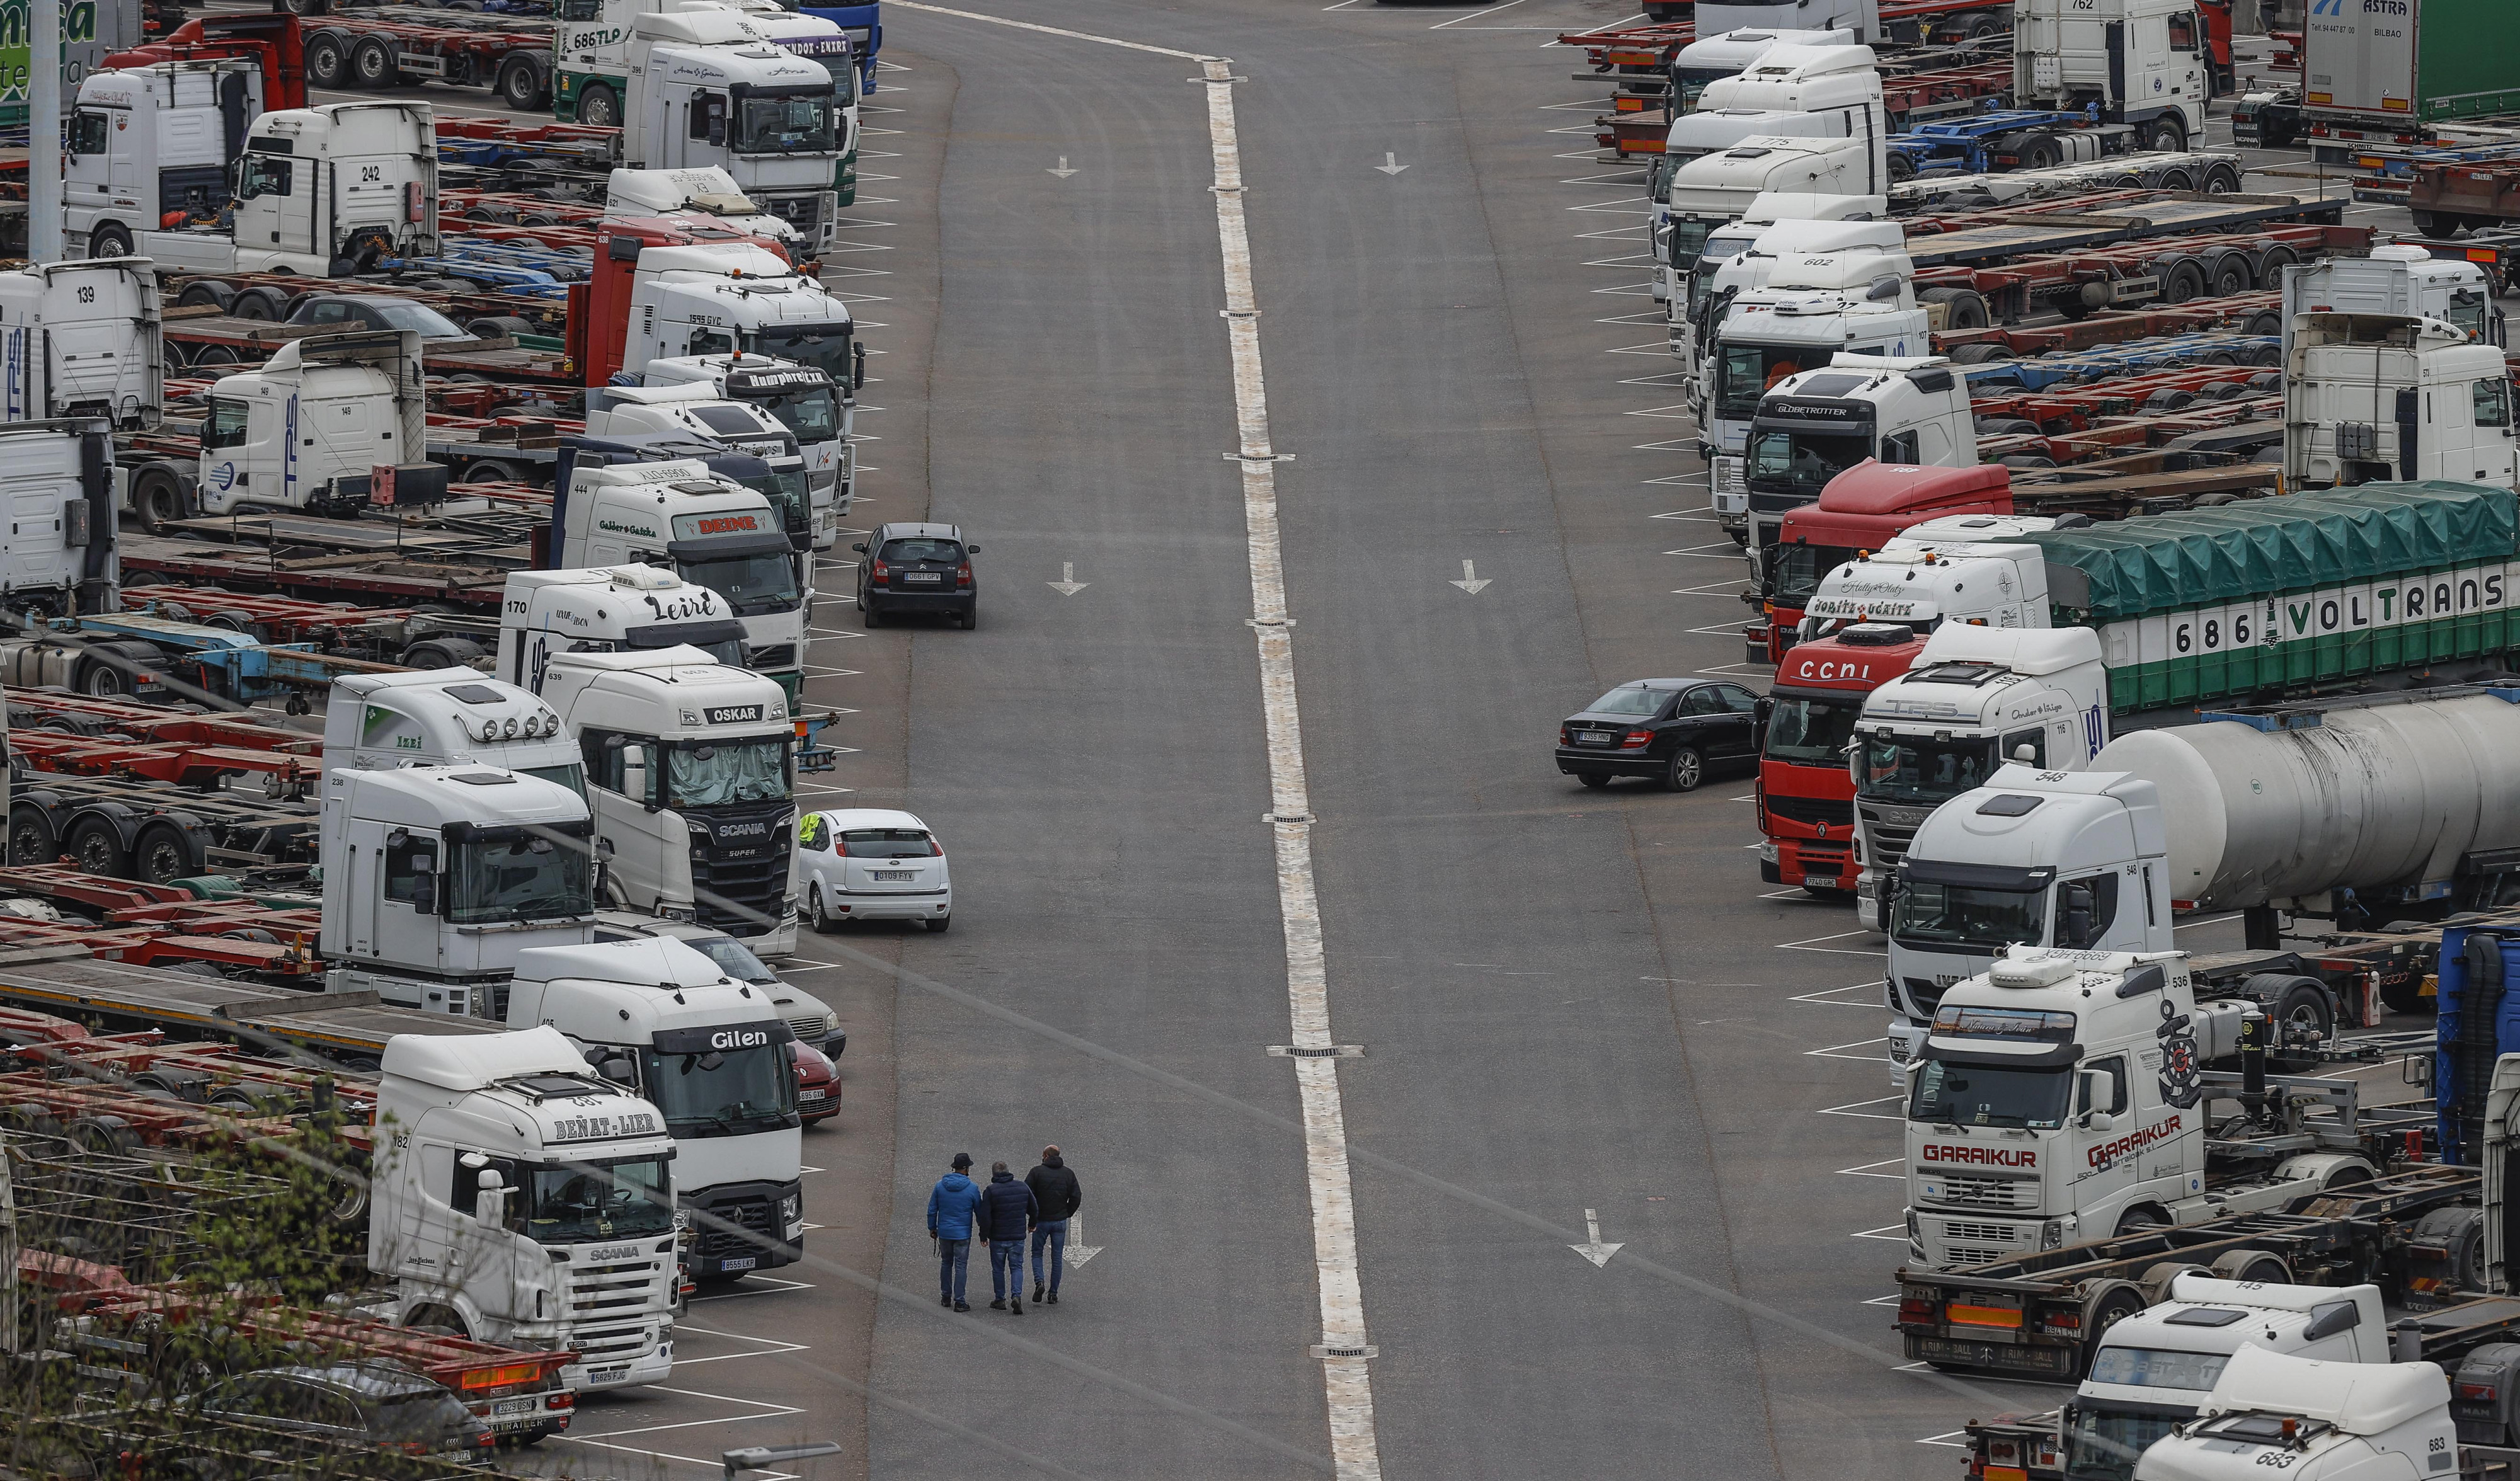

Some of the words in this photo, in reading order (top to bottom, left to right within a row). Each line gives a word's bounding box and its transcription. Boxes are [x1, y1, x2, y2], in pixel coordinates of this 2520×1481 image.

[2072, 0, 2093, 9] 762
[2363, 0, 2407, 16] ASTRA
[575, 32, 595, 50] 686
[597, 28, 621, 45] TLP
[2374, 28, 2402, 38] BILBAO
[632, 66, 642, 74] 396
[1870, 93, 1880, 101] 744
[362, 166, 381, 181] 242
[609, 198, 618, 207] 621
[598, 236, 609, 244] 638
[77, 285, 95, 304] 139
[689, 314, 706, 323] 1595
[707, 315, 722, 326] GYC
[1918, 330, 1927, 340] 107
[8, 327, 22, 424] TPS
[260, 386, 269, 396] 149
[341, 406, 352, 416] 149
[1777, 405, 1847, 416] GLOBETROTTER
[285, 393, 297, 498] TPS
[575, 484, 588, 495] 444
[698, 515, 757, 534] DEINE
[1841, 580, 1874, 597] Holly
[508, 600, 527, 614] 170
[2288, 574, 2502, 635] VOLTRANS
[556, 609, 572, 620] UXUE
[2176, 614, 2250, 653] 686
[548, 673, 562, 681] 639
[1886, 699, 1958, 716] TPS
[713, 707, 757, 722] OSKAR
[2057, 723, 2066, 735] 116
[1583, 732, 1597, 740] 9355
[1598, 733, 1609, 741] HNG
[332, 778, 344, 787] 238
[2035, 772, 2068, 782] 548
[719, 823, 766, 838] SCANIA
[899, 872, 912, 880] FYV
[2126, 864, 2137, 876] 548
[1823, 878, 1836, 886] GRC
[2172, 975, 2187, 988] 536
[711, 1030, 767, 1049] Gilen
[813, 1089, 825, 1099] GXM
[2087, 1114, 2181, 1169] GARAIKUR
[1923, 1144, 2036, 1168] GARAIKUR
[590, 1245, 639, 1261] SCANIA
[726, 1260, 742, 1269] 8555
[743, 1259, 755, 1267] LKP
[2235, 1281, 2266, 1290] 145
[595, 1373, 611, 1382] 5625
[612, 1371, 626, 1380] FJG
[500, 1403, 516, 1412] 3229
[2429, 1436, 2445, 1452] 683
[2255, 1451, 2296, 1469] 683
